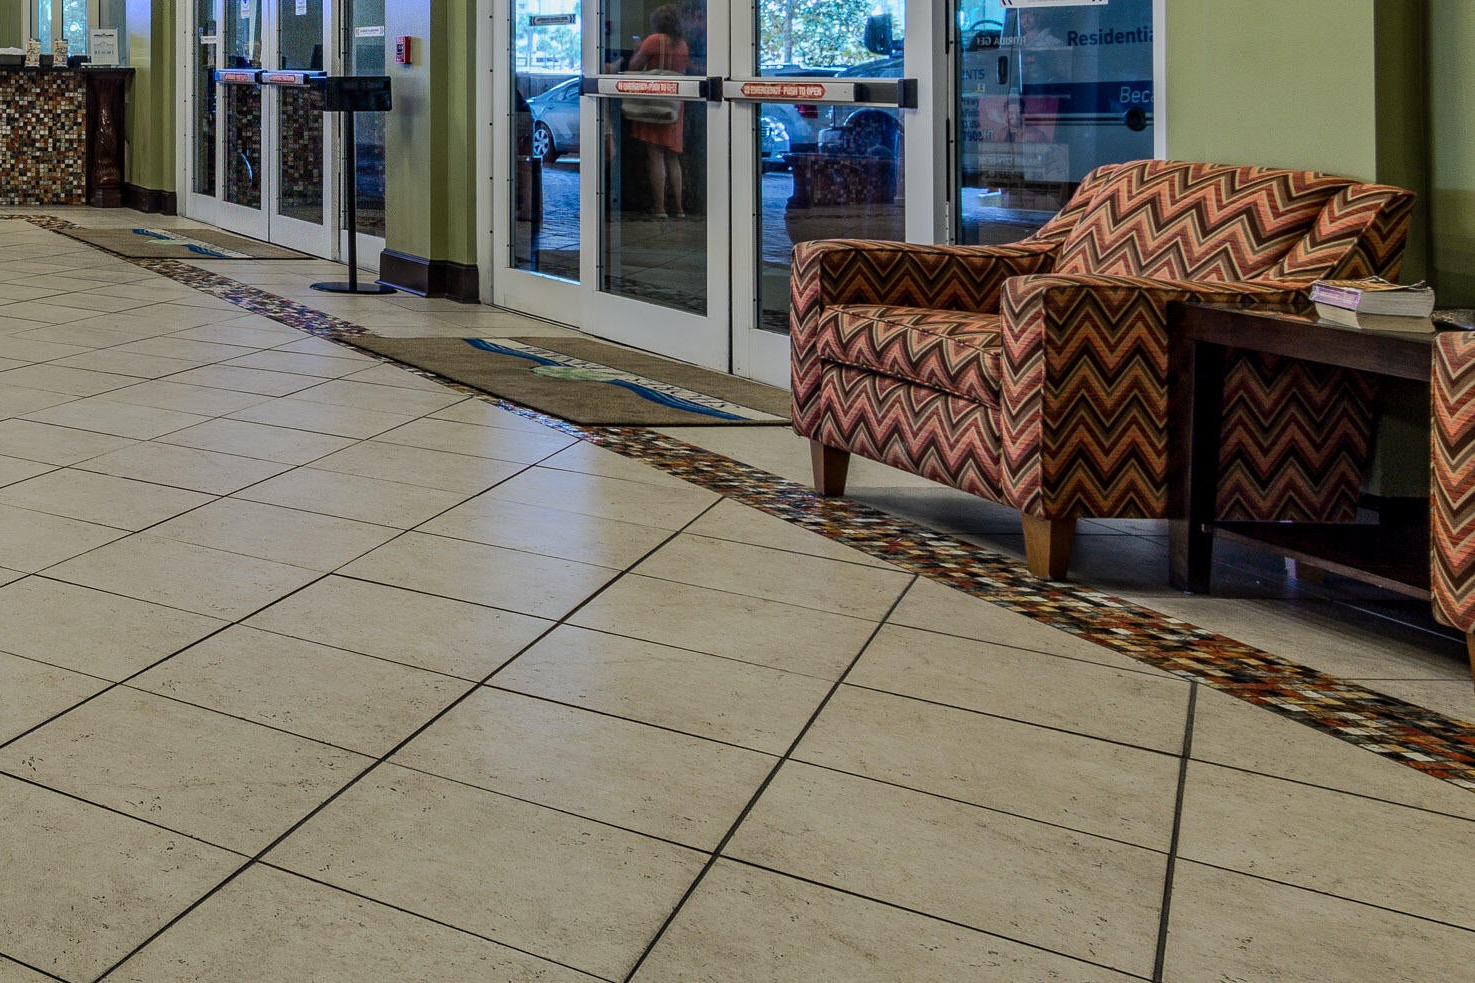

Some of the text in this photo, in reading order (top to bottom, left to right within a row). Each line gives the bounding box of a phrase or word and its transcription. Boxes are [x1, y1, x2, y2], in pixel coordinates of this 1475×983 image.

[783, 85, 798, 95] PUSH
[799, 85, 806, 95] TO
[806, 86, 822, 96] OPEN
